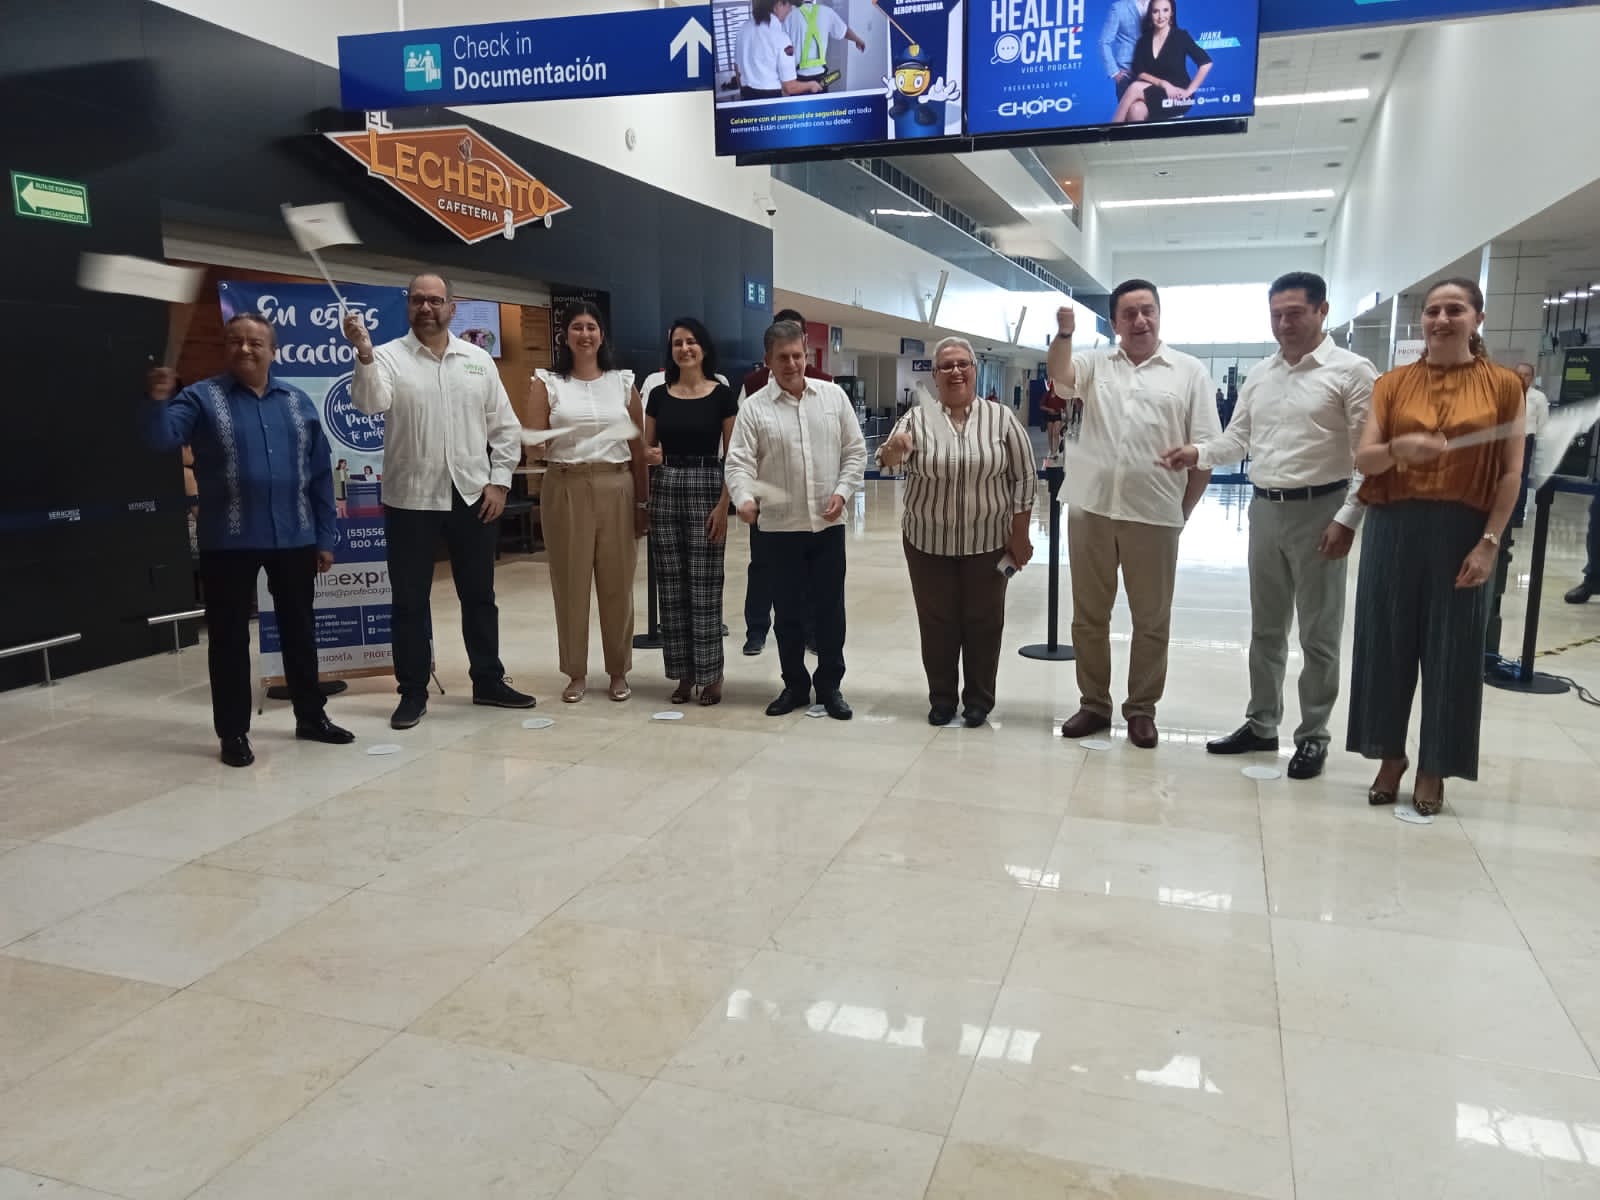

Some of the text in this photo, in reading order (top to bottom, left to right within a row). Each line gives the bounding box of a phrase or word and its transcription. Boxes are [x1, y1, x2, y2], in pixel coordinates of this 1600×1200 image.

[991, 0, 1084, 32] HEALTH
[453, 31, 532, 60] Check in
[454, 56, 607, 91] Documentación
[1021, 62, 1082, 74] VIDEO PODCAST
[368, 111, 393, 129] EL
[730, 116, 757, 125] Colabore
[778, 112, 804, 122] personal
[815, 109, 847, 119] seguridad
[368, 128, 549, 217] LECHERITO
[437, 198, 499, 223] CAFETERIA
[256, 295, 379, 339] En estas
[347, 527, 385, 539] (55)556
[350, 538, 387, 549] 800 46
